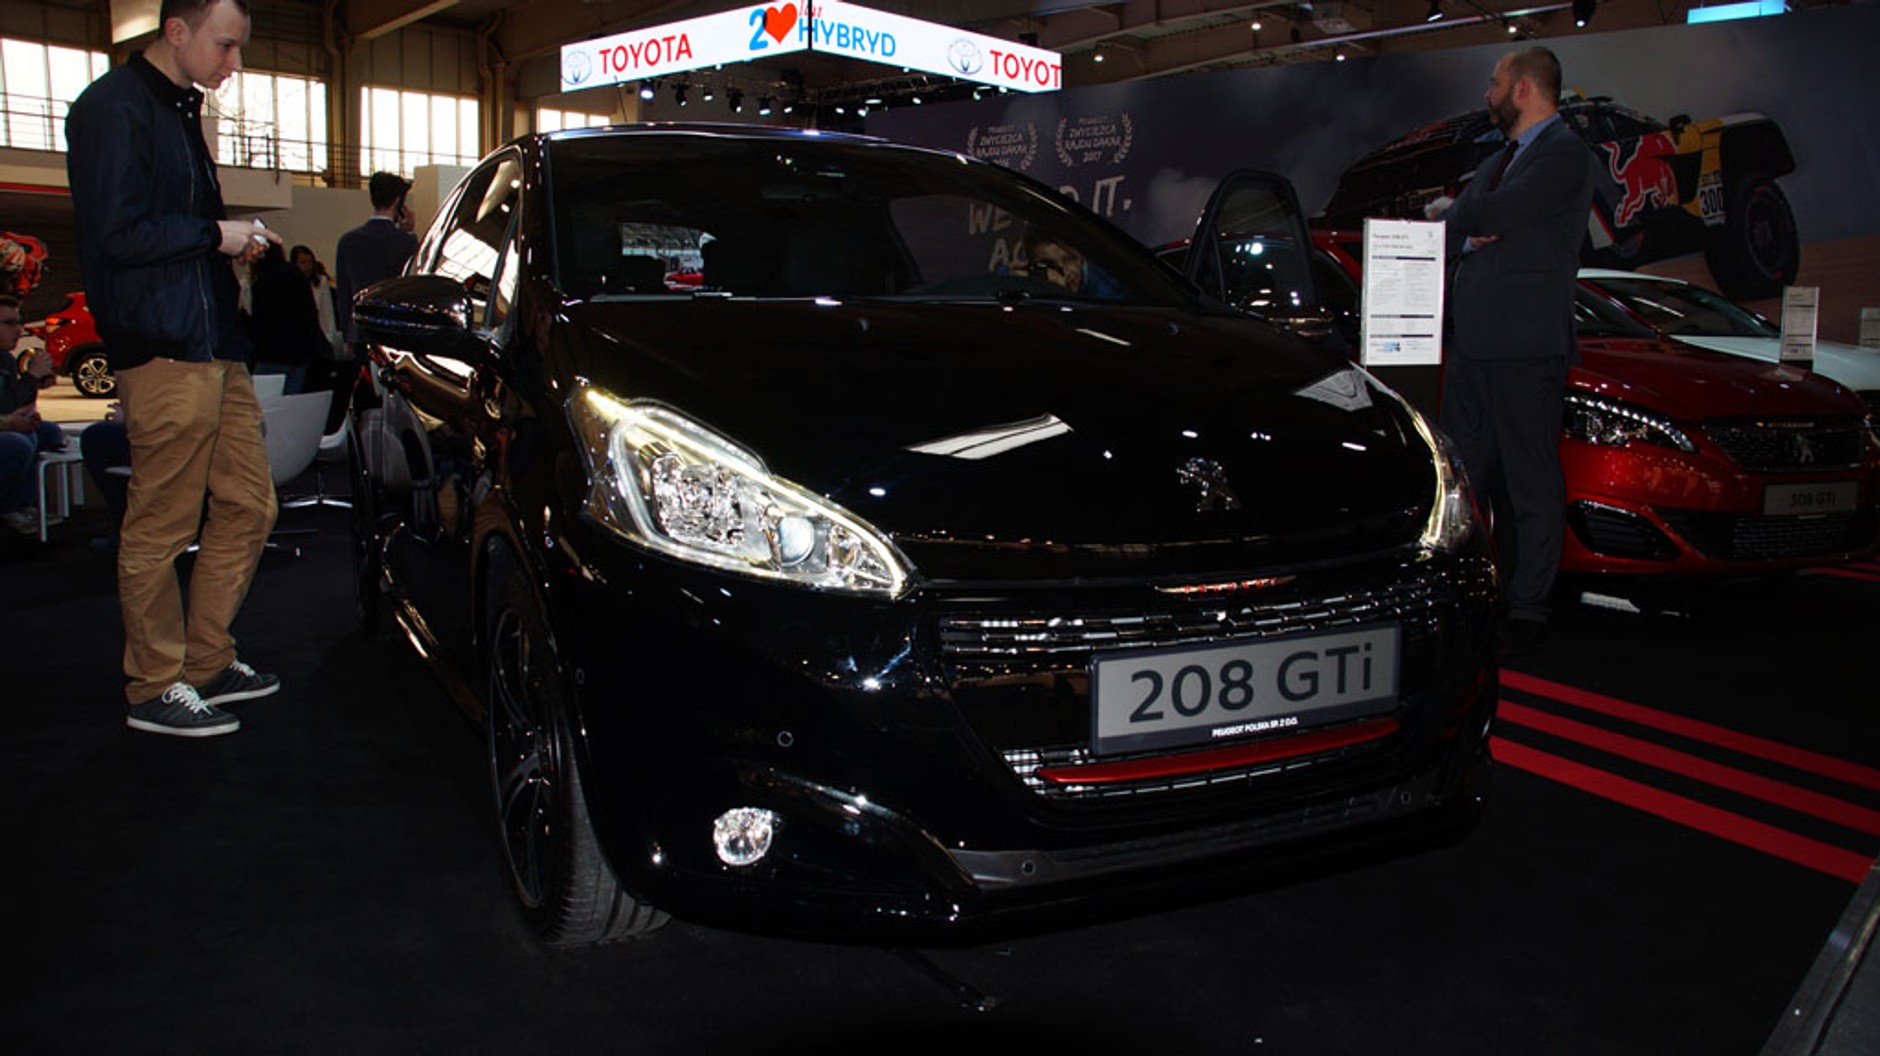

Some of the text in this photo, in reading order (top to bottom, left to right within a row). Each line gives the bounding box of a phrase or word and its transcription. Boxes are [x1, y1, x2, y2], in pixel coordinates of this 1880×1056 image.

[598, 33, 693, 75] TOYOTA
[798, 17, 897, 58] HYBRYD
[989, 49, 1062, 88] TOYOT
[1128, 642, 1372, 723] 208 GTi
[1211, 724, 1244, 738] PEUGEOT
[1244, 721, 1270, 733] POLSKA
